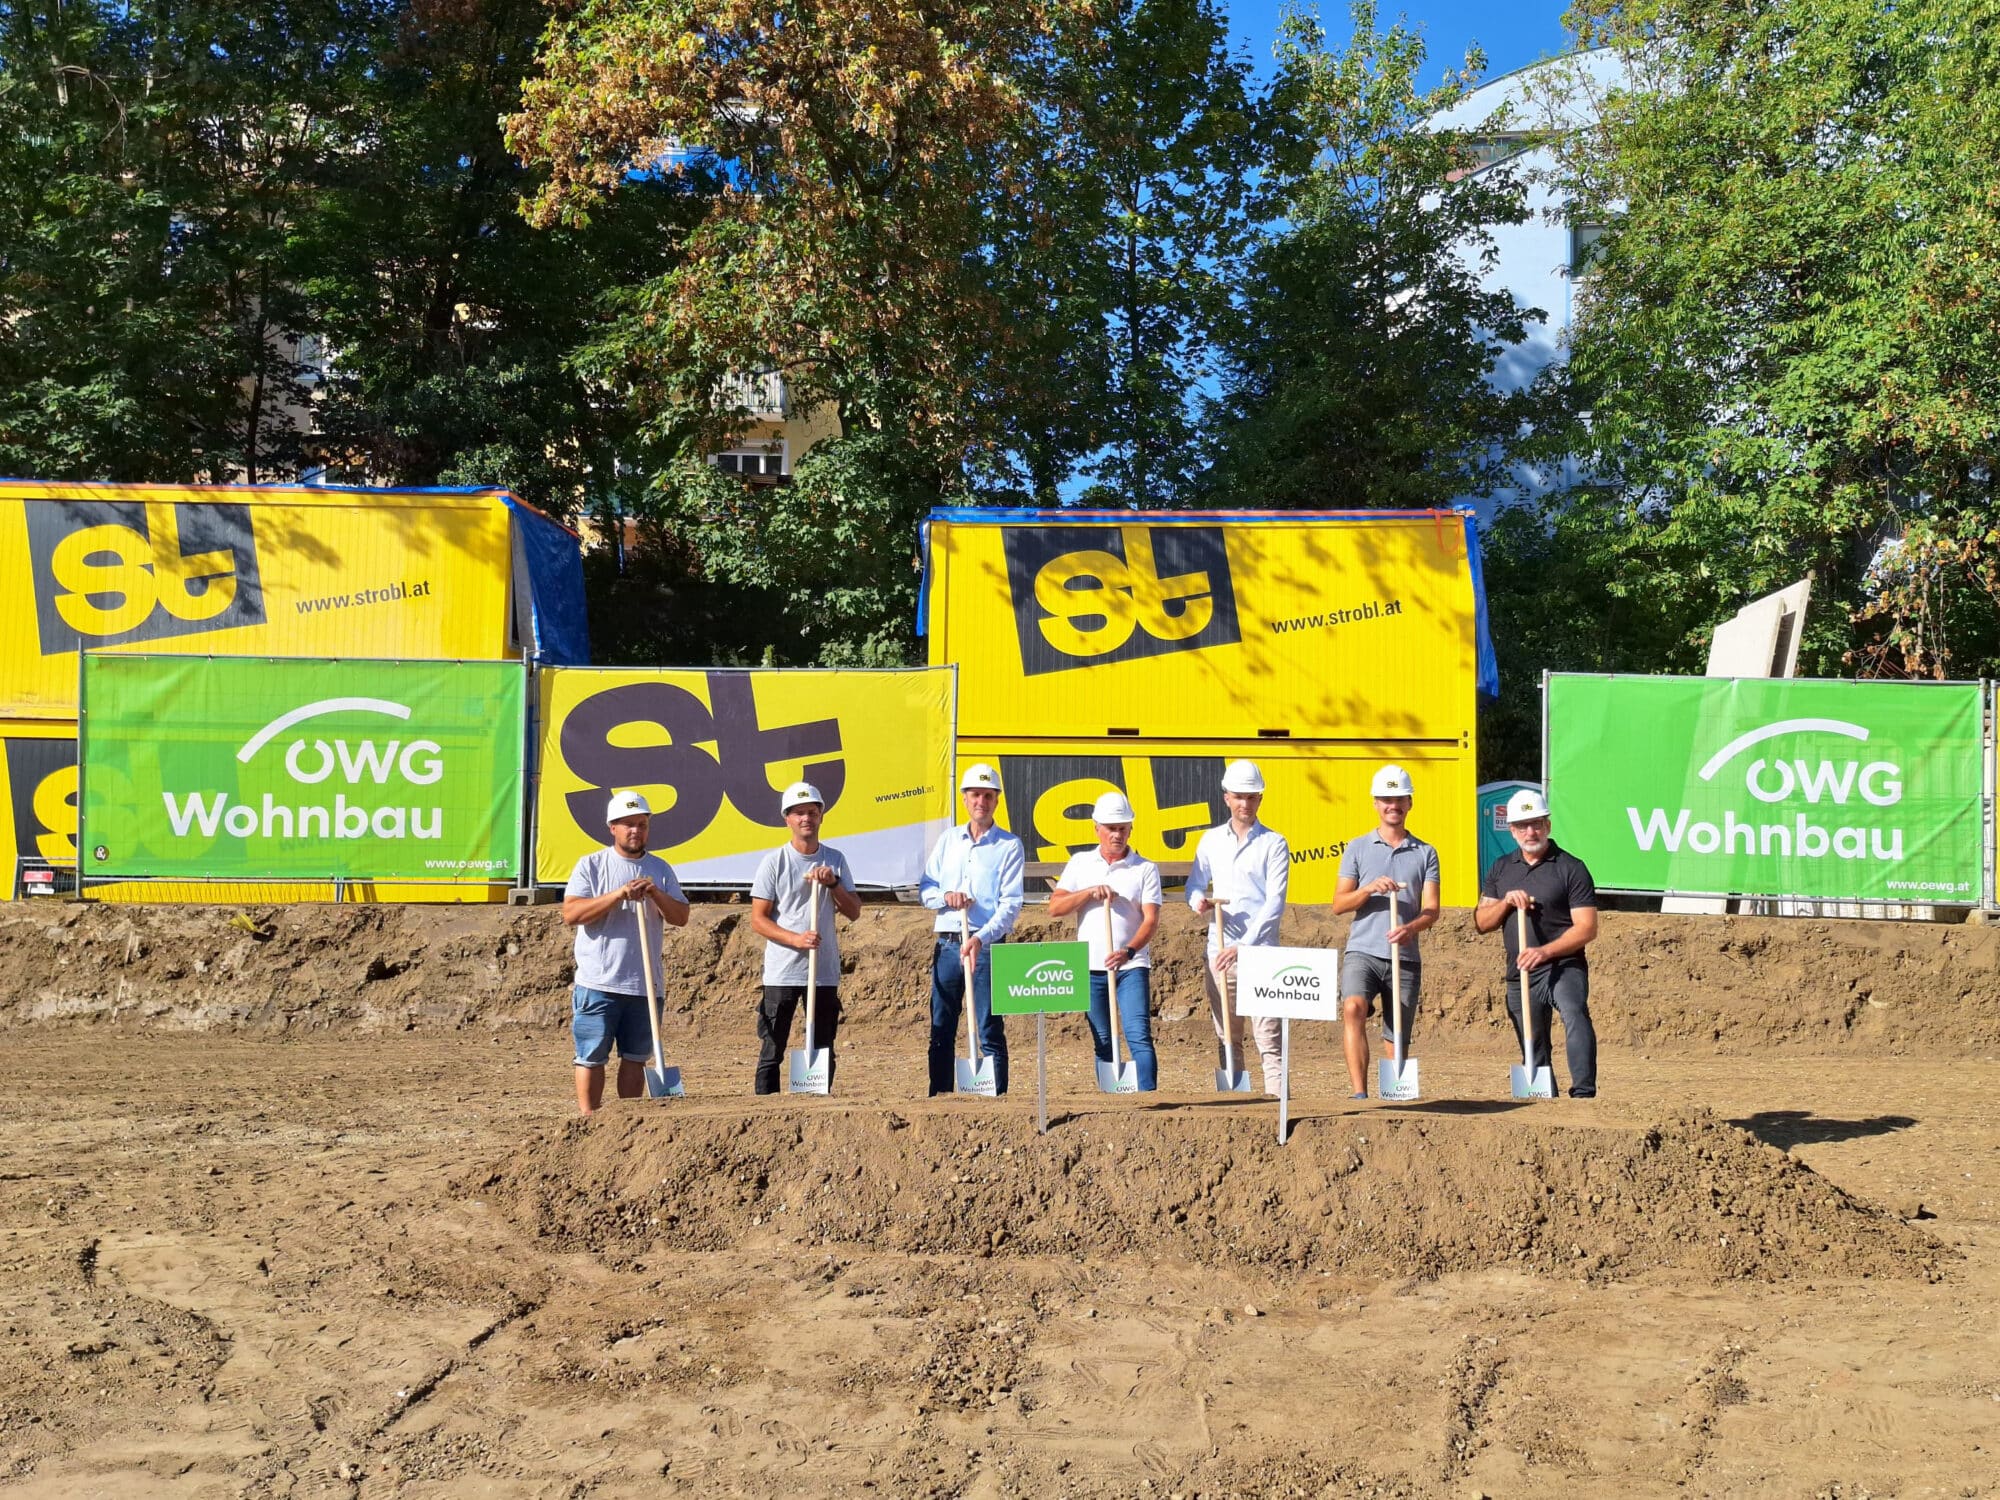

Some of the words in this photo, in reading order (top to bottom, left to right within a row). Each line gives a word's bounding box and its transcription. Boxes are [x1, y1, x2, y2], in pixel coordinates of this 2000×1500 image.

[296, 579, 432, 614] www.strobl.at
[1271, 599, 1403, 634] www.strobl.at
[875, 785, 935, 802] www.strobl.at
[162, 792, 443, 839] Wohnbau
[1627, 808, 1903, 860] Wohnbau
[425, 858, 509, 871] www.oewg.at
[1887, 880, 1970, 893] www.oewg.at
[1008, 984, 1074, 997] Wohnbau
[1254, 986, 1320, 1001] Wohnbau
